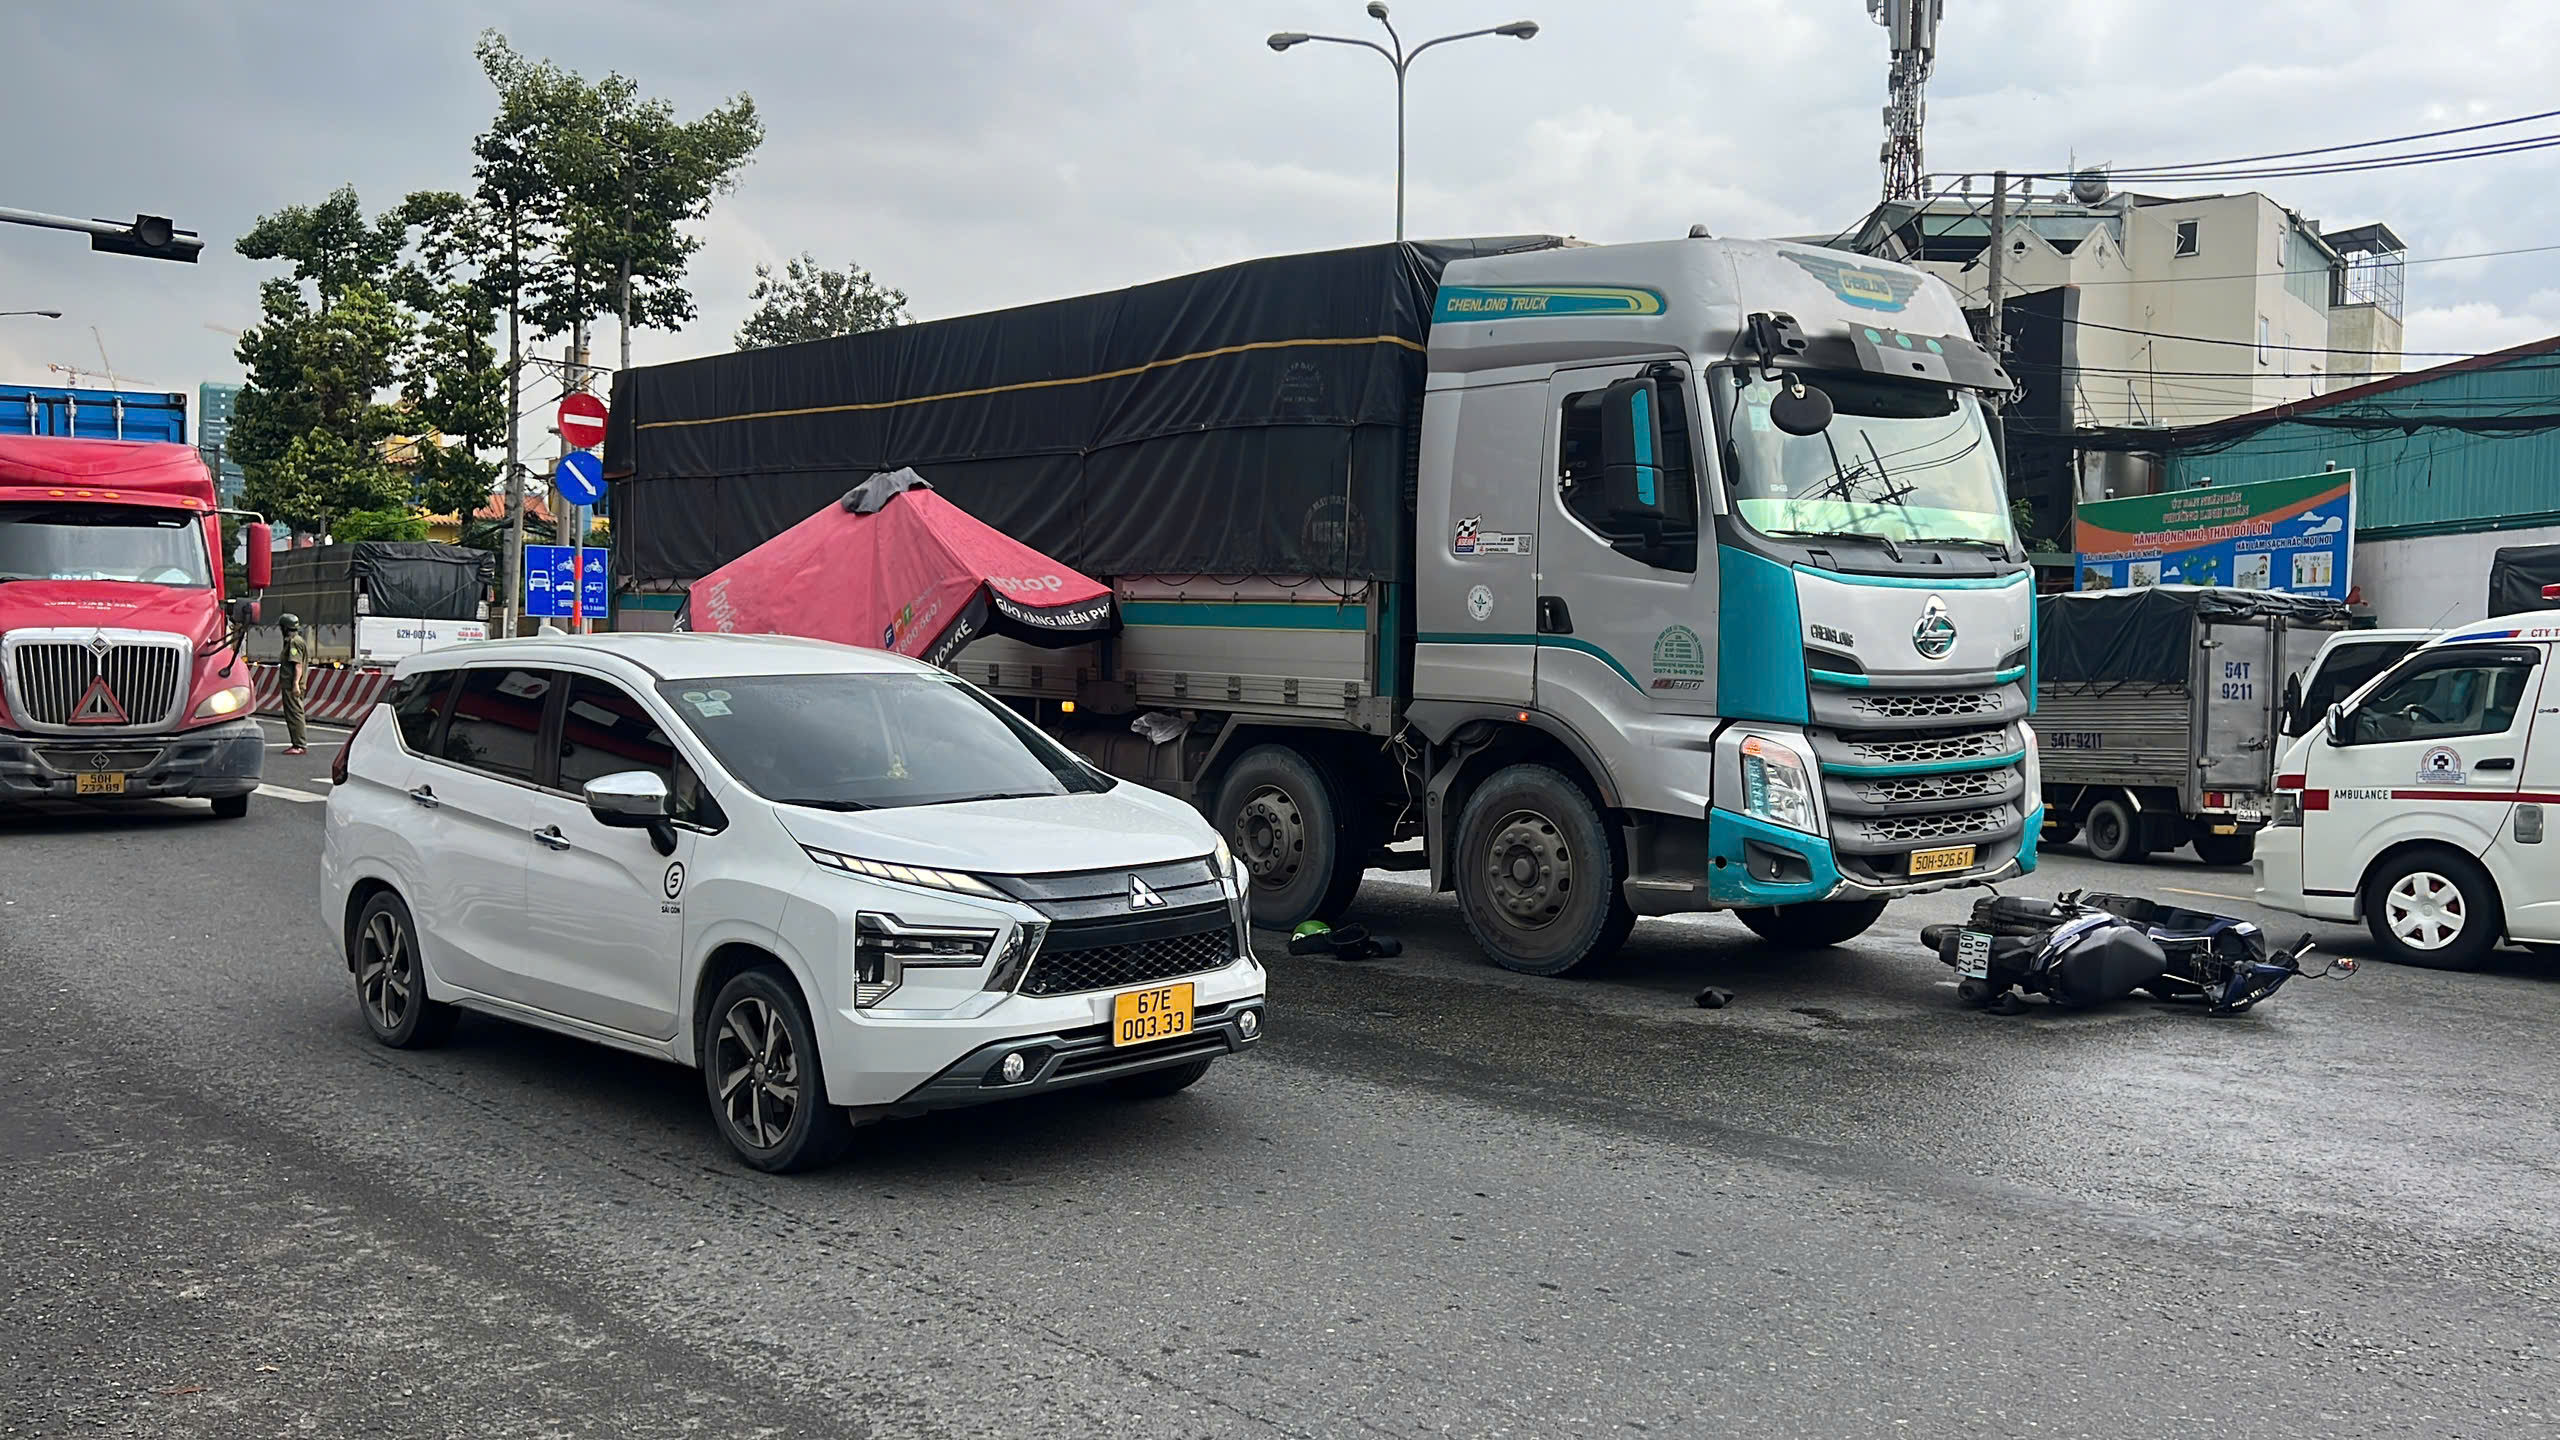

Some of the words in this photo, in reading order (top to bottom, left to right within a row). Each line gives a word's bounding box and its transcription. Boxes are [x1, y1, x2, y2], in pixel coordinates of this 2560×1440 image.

[1447, 297, 1506, 312] CHENLONG
[1511, 296, 1550, 311] TRUCK
[2133, 531, 2157, 545] HÀNH
[2159, 529, 2182, 545] ĐỘNG
[2209, 525, 2232, 538] THAY
[2252, 520, 2272, 535] LỚN
[2267, 538, 2286, 551] SẠCH
[2287, 536, 2302, 548] RÁC
[1056, 609, 1090, 626] MIỄN
[396, 629, 437, 640] 62H-007.54
[2531, 628, 2552, 638] CTY
[2225, 662, 2251, 679] 54T
[2222, 683, 2252, 700] 9211
[2051, 732, 2102, 748] 54T-9211
[2334, 790, 2389, 800] AMBULANCE
[1915, 851, 1969, 871] 50H-926.61
[1958, 934, 1974, 974] 091.22
[1972, 941, 1988, 972] 61-CA
[1138, 989, 1171, 1014] 67E
[1123, 1011, 1184, 1041] 003.33
